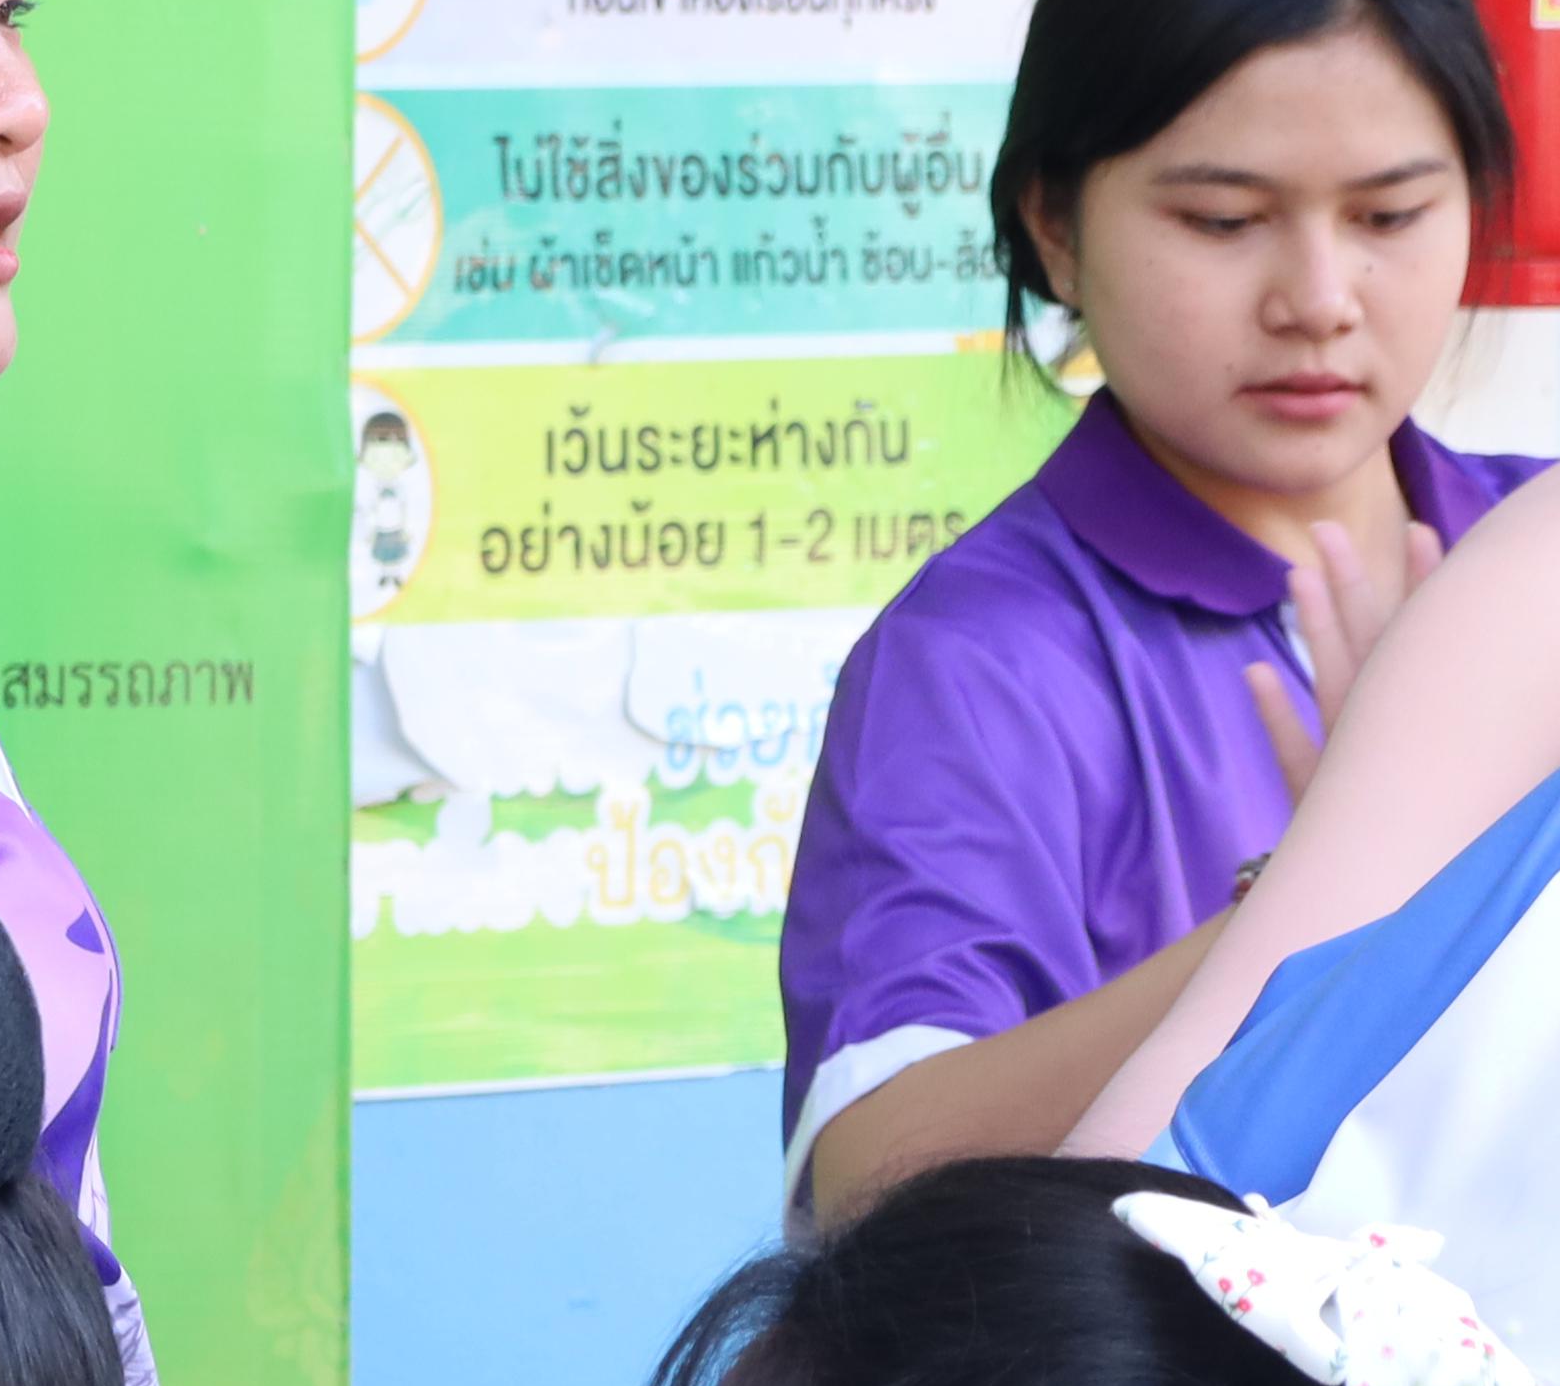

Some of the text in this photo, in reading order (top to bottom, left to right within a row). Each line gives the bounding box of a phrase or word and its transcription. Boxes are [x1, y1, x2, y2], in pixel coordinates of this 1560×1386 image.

[493, 113, 984, 219] ไม่ใช้สิ่งของร่วมกับผู้อื่น
[861, 228, 1002, 284] ช้อน-ส้อ
[544, 398, 911, 477] เว้นระยะห่างกัน
[480, 493, 726, 575] อย่างน้อย
[750, 508, 834, 569] 1-2
[663, 665, 838, 771] ช่วยก
[587, 787, 792, 911] ป้องกั
